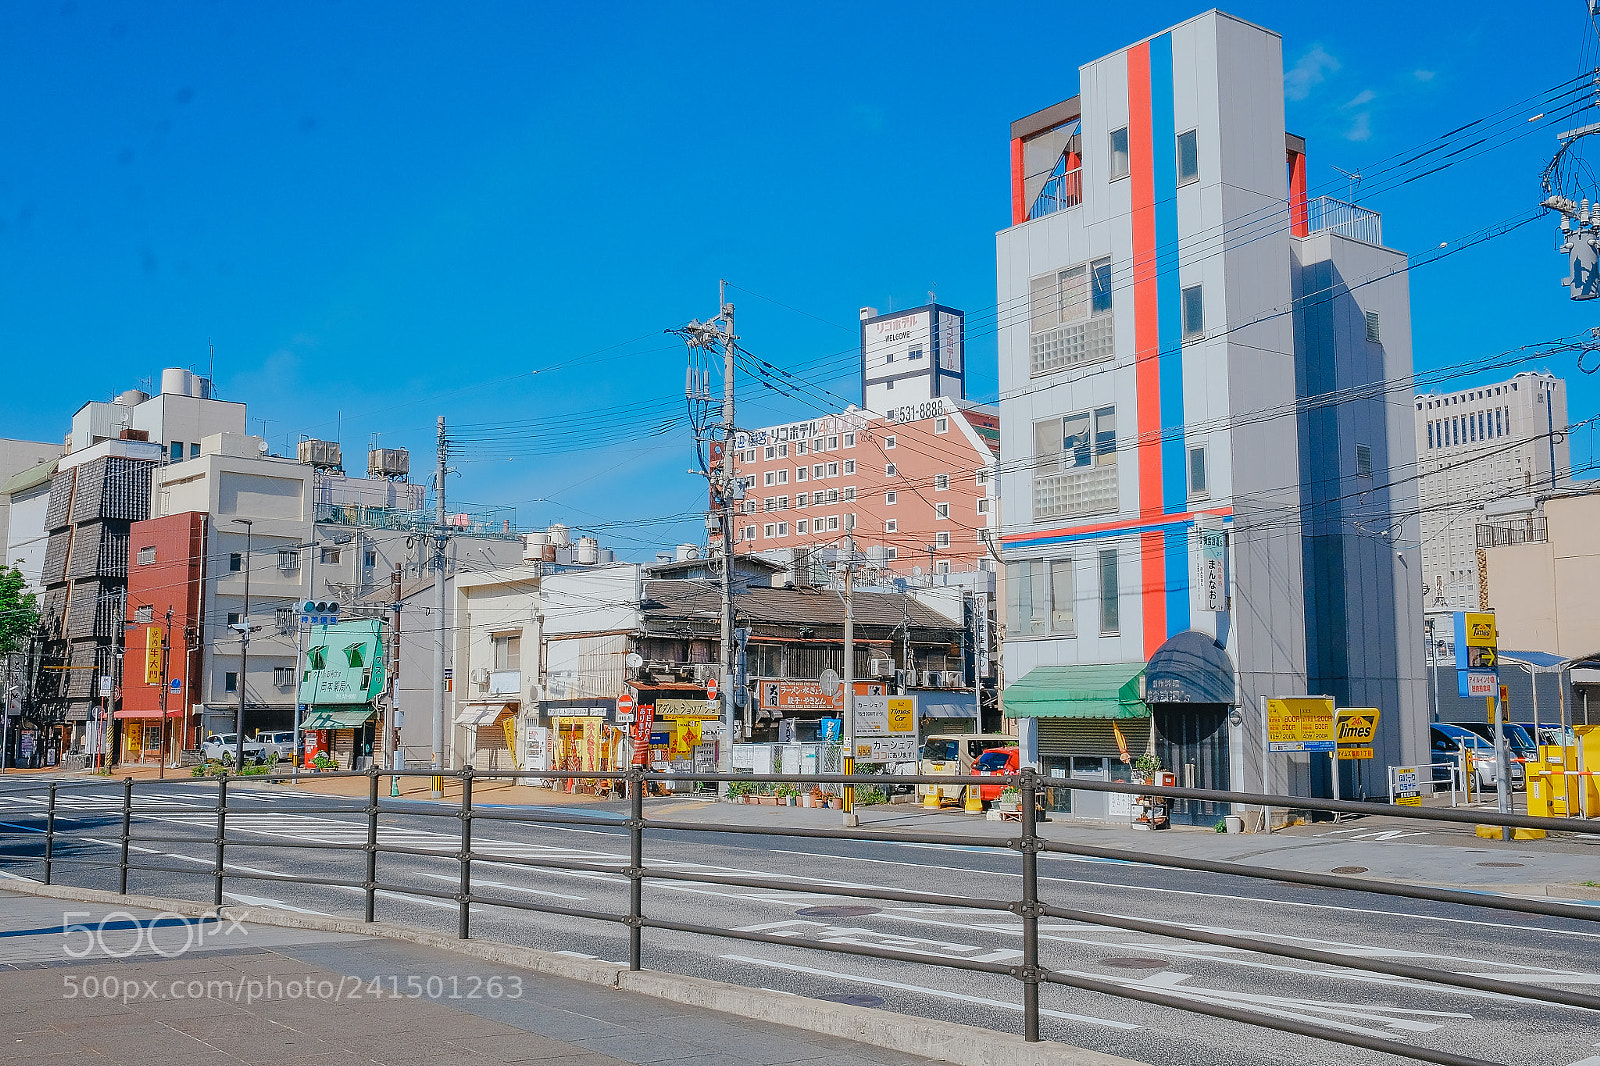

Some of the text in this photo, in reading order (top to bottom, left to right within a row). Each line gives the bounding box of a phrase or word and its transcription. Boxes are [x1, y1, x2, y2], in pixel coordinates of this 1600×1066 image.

[877, 316, 917, 334] リコホテル
[885, 331, 911, 342] WELCOME
[946, 314, 954, 370] リコホテル
[900, 400, 943, 422] 531-8888
[771, 421, 818, 444] リコホテル
[1208, 559, 1217, 610] まんなおし
[780, 686, 824, 695] ラーメン・水ぎょう
[644, 708, 653, 742] TENGA
[1338, 723, 1371, 739] Times
[873, 740, 914, 750] カーシェア
